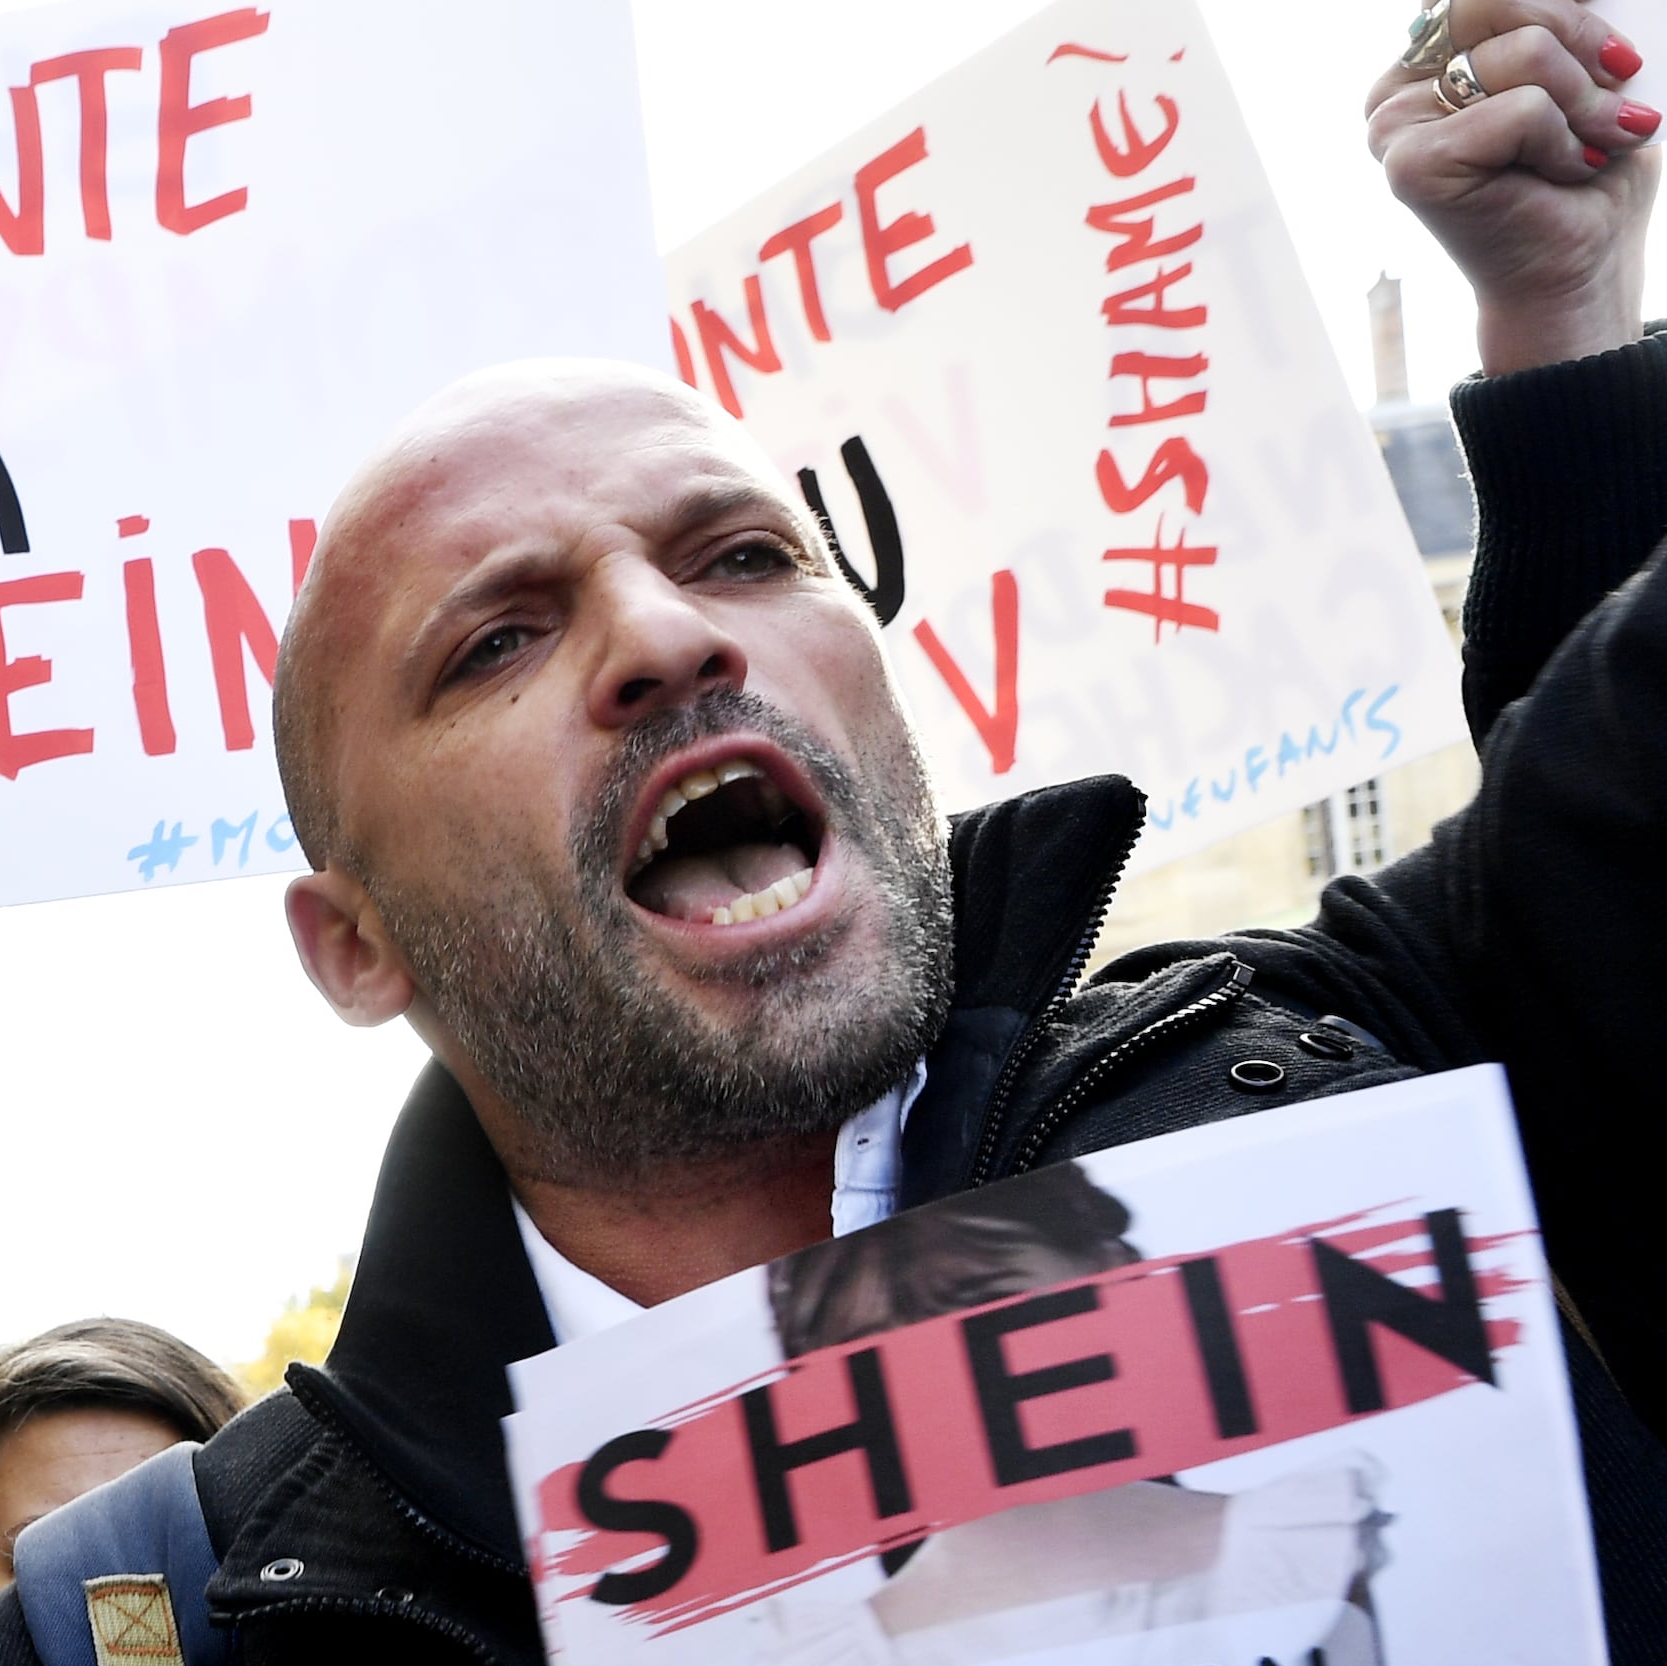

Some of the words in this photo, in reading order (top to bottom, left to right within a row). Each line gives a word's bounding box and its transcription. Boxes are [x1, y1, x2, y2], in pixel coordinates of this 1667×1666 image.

[670, 126, 974, 421] NTE
[797, 435, 905, 628] U
[577, 1209, 1501, 1607] SHEIN
